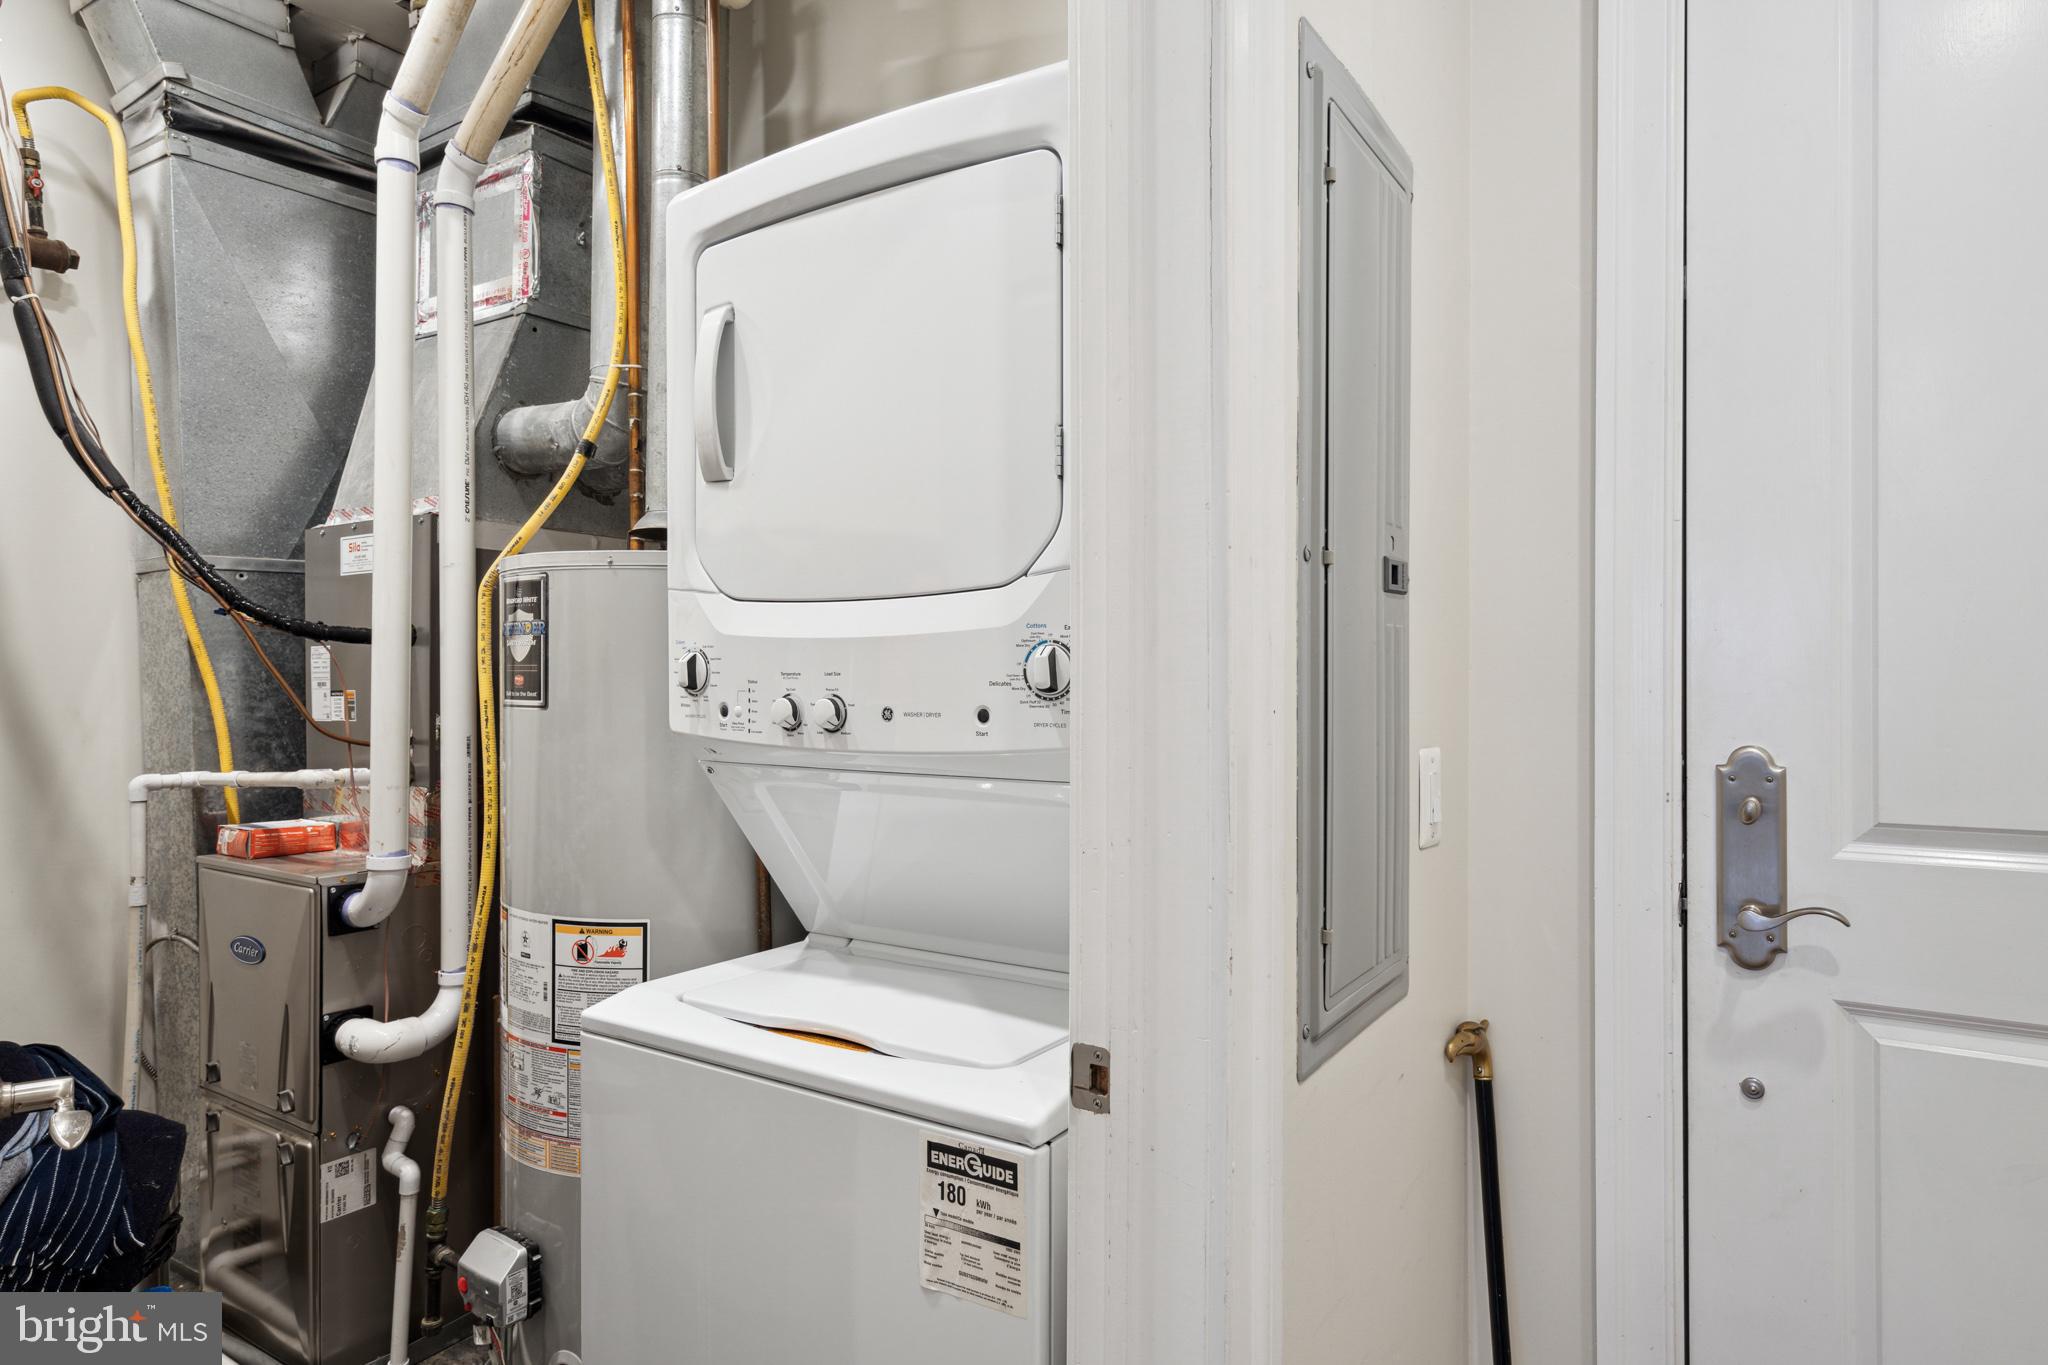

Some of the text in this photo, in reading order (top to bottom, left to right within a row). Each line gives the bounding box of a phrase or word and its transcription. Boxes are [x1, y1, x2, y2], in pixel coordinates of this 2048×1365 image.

[234, 942, 259, 957] Carrier
[930, 1150, 1014, 1184] ENERGUIDE
[937, 1179, 966, 1207] 180
[976, 1198, 991, 1211] kWh
